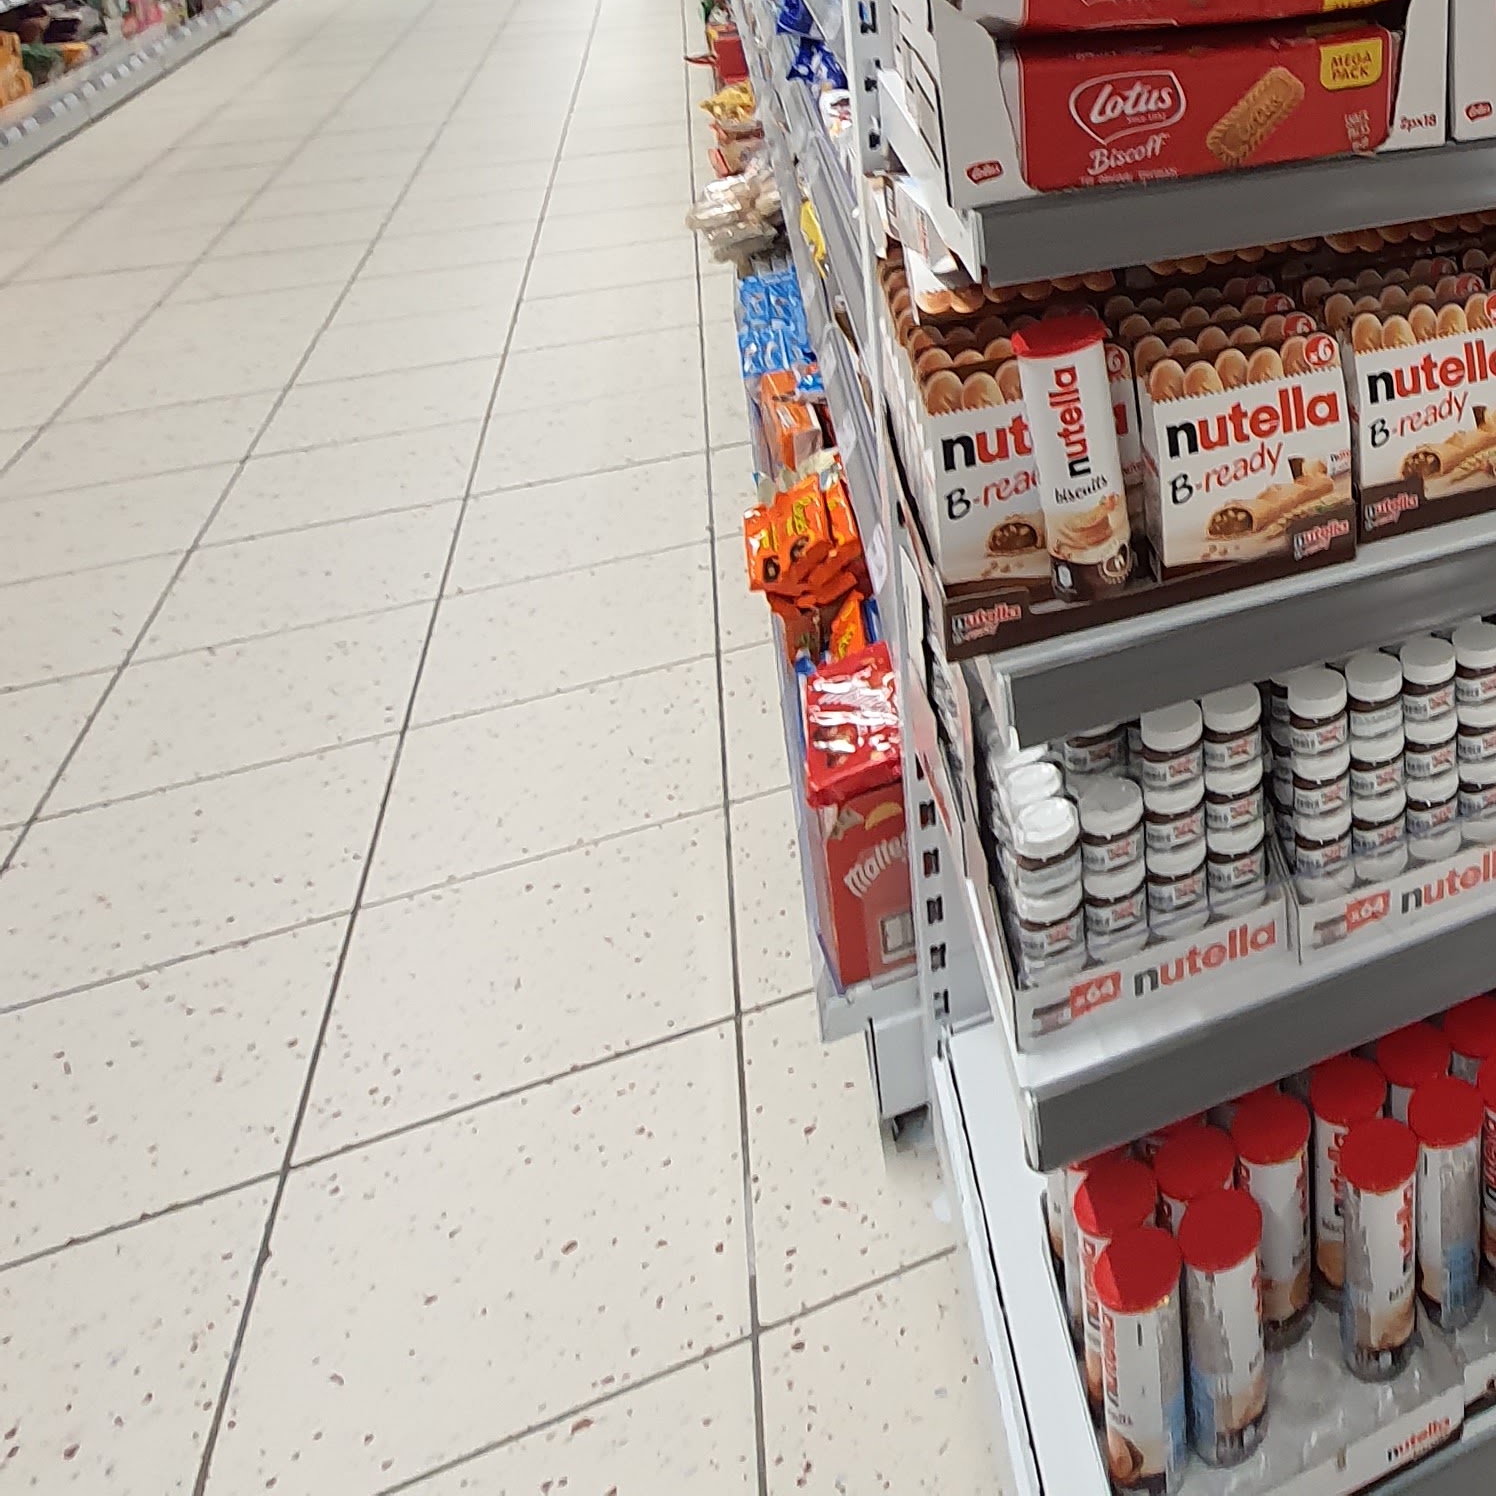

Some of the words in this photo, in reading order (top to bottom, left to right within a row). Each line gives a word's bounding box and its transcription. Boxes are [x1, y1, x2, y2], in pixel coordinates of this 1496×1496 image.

[1331, 50, 1372, 67] MEGA
[1332, 64, 1369, 81] PACK
[1089, 80, 1173, 124] Lotus
[1087, 132, 1171, 176] Biscoff
[1048, 366, 1091, 478] nutella
[1165, 384, 1340, 458] nutella
[1054, 474, 1109, 505] biscuits
[1133, 919, 1277, 998] nutella
